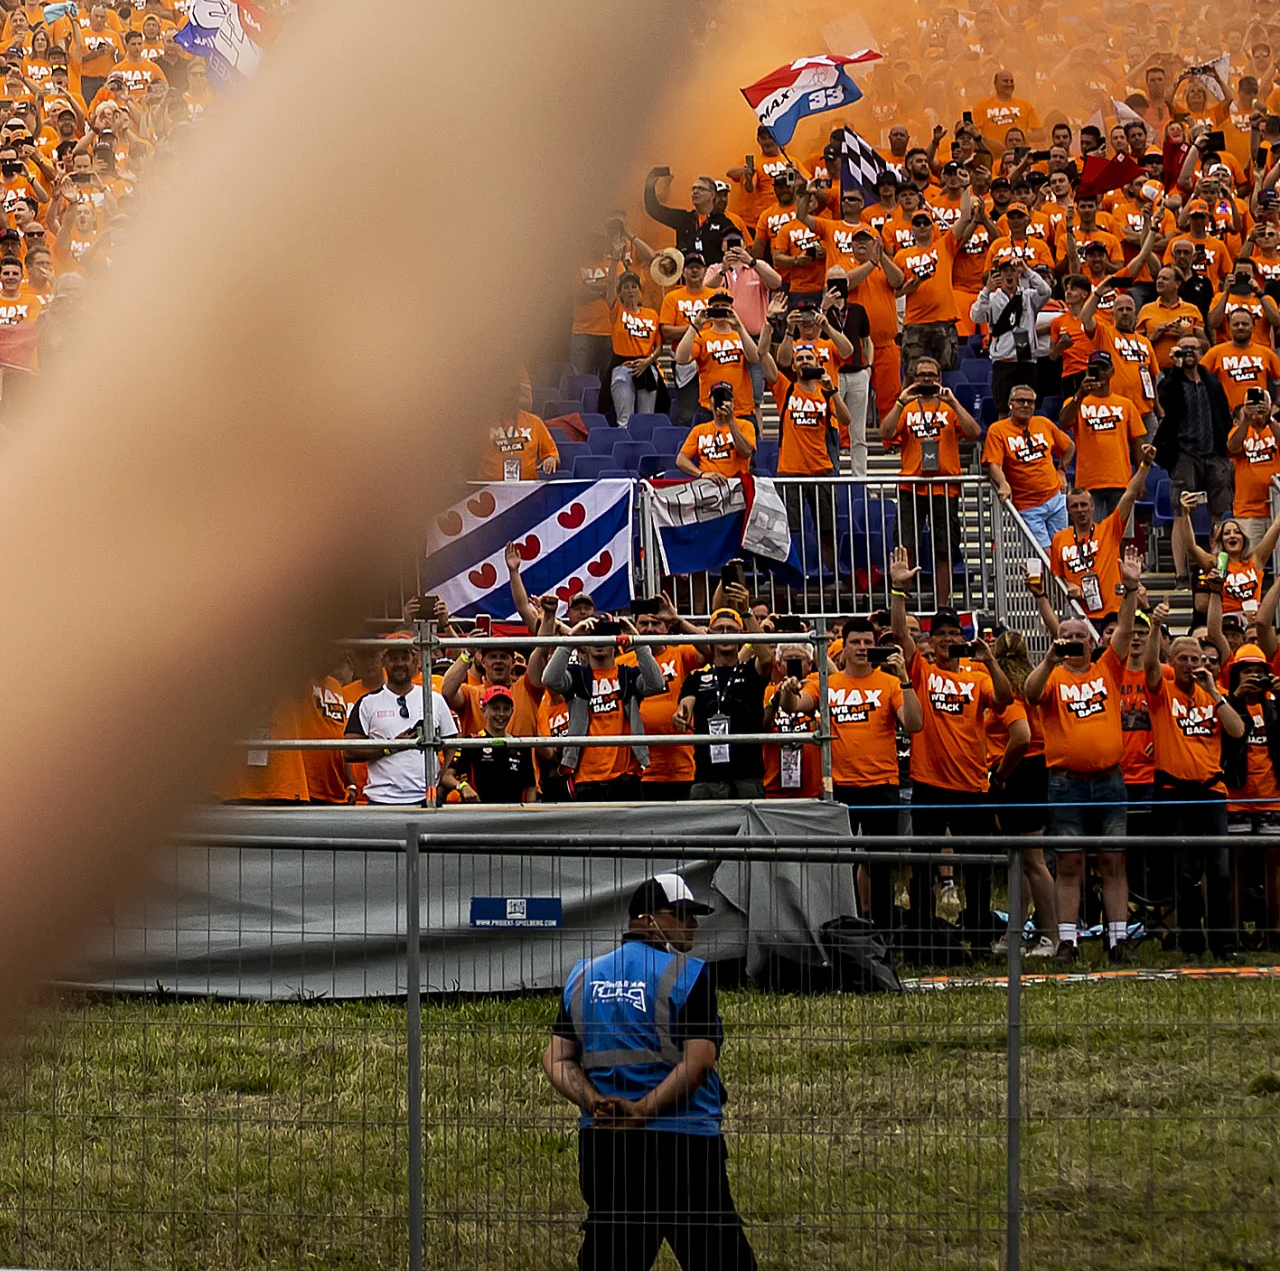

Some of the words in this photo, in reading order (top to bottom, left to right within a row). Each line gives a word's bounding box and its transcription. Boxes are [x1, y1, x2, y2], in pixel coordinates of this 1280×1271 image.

[122, 71, 151, 81] MAX
[808, 85, 845, 110] 33
[759, 89, 791, 122] MAX
[987, 107, 1020, 118] MAX
[906, 250, 938, 268] MAX
[1225, 303, 1262, 318] MAX
[629, 328, 649, 337] BACK
[707, 340, 744, 353] MAX
[713, 351, 727, 360] WE
[719, 354, 739, 364] BACK
[1223, 356, 1263, 371] MAX
[1229, 369, 1243, 378] WE
[1236, 373, 1256, 381] BACK
[788, 396, 827, 415] MAX
[792, 411, 805, 419] WE
[1081, 404, 1123, 419] MAX
[796, 417, 817, 425] BACK
[907, 412, 948, 425] MAX
[1088, 418, 1102, 426] WE
[1092, 421, 1114, 431] BACK
[1008, 433, 1048, 451] MAX
[1018, 449, 1031, 458] WE
[1023, 452, 1044, 462] BACK
[1249, 454, 1271, 462] BACK
[1068, 557, 1082, 566] WE
[1226, 569, 1258, 588] MAX
[928, 673, 974, 701] MAX
[1060, 678, 1107, 701] MAX
[828, 688, 882, 706] MAX
[931, 692, 946, 702] WE
[593, 700, 617, 713] BACK
[831, 705, 849, 715] WE
[850, 702, 871, 712] ARE
[935, 702, 959, 711] BACK
[1070, 700, 1086, 710] WE
[1078, 703, 1102, 718] BACK
[838, 711, 866, 722] BACK
[1186, 726, 1210, 735] BACK
